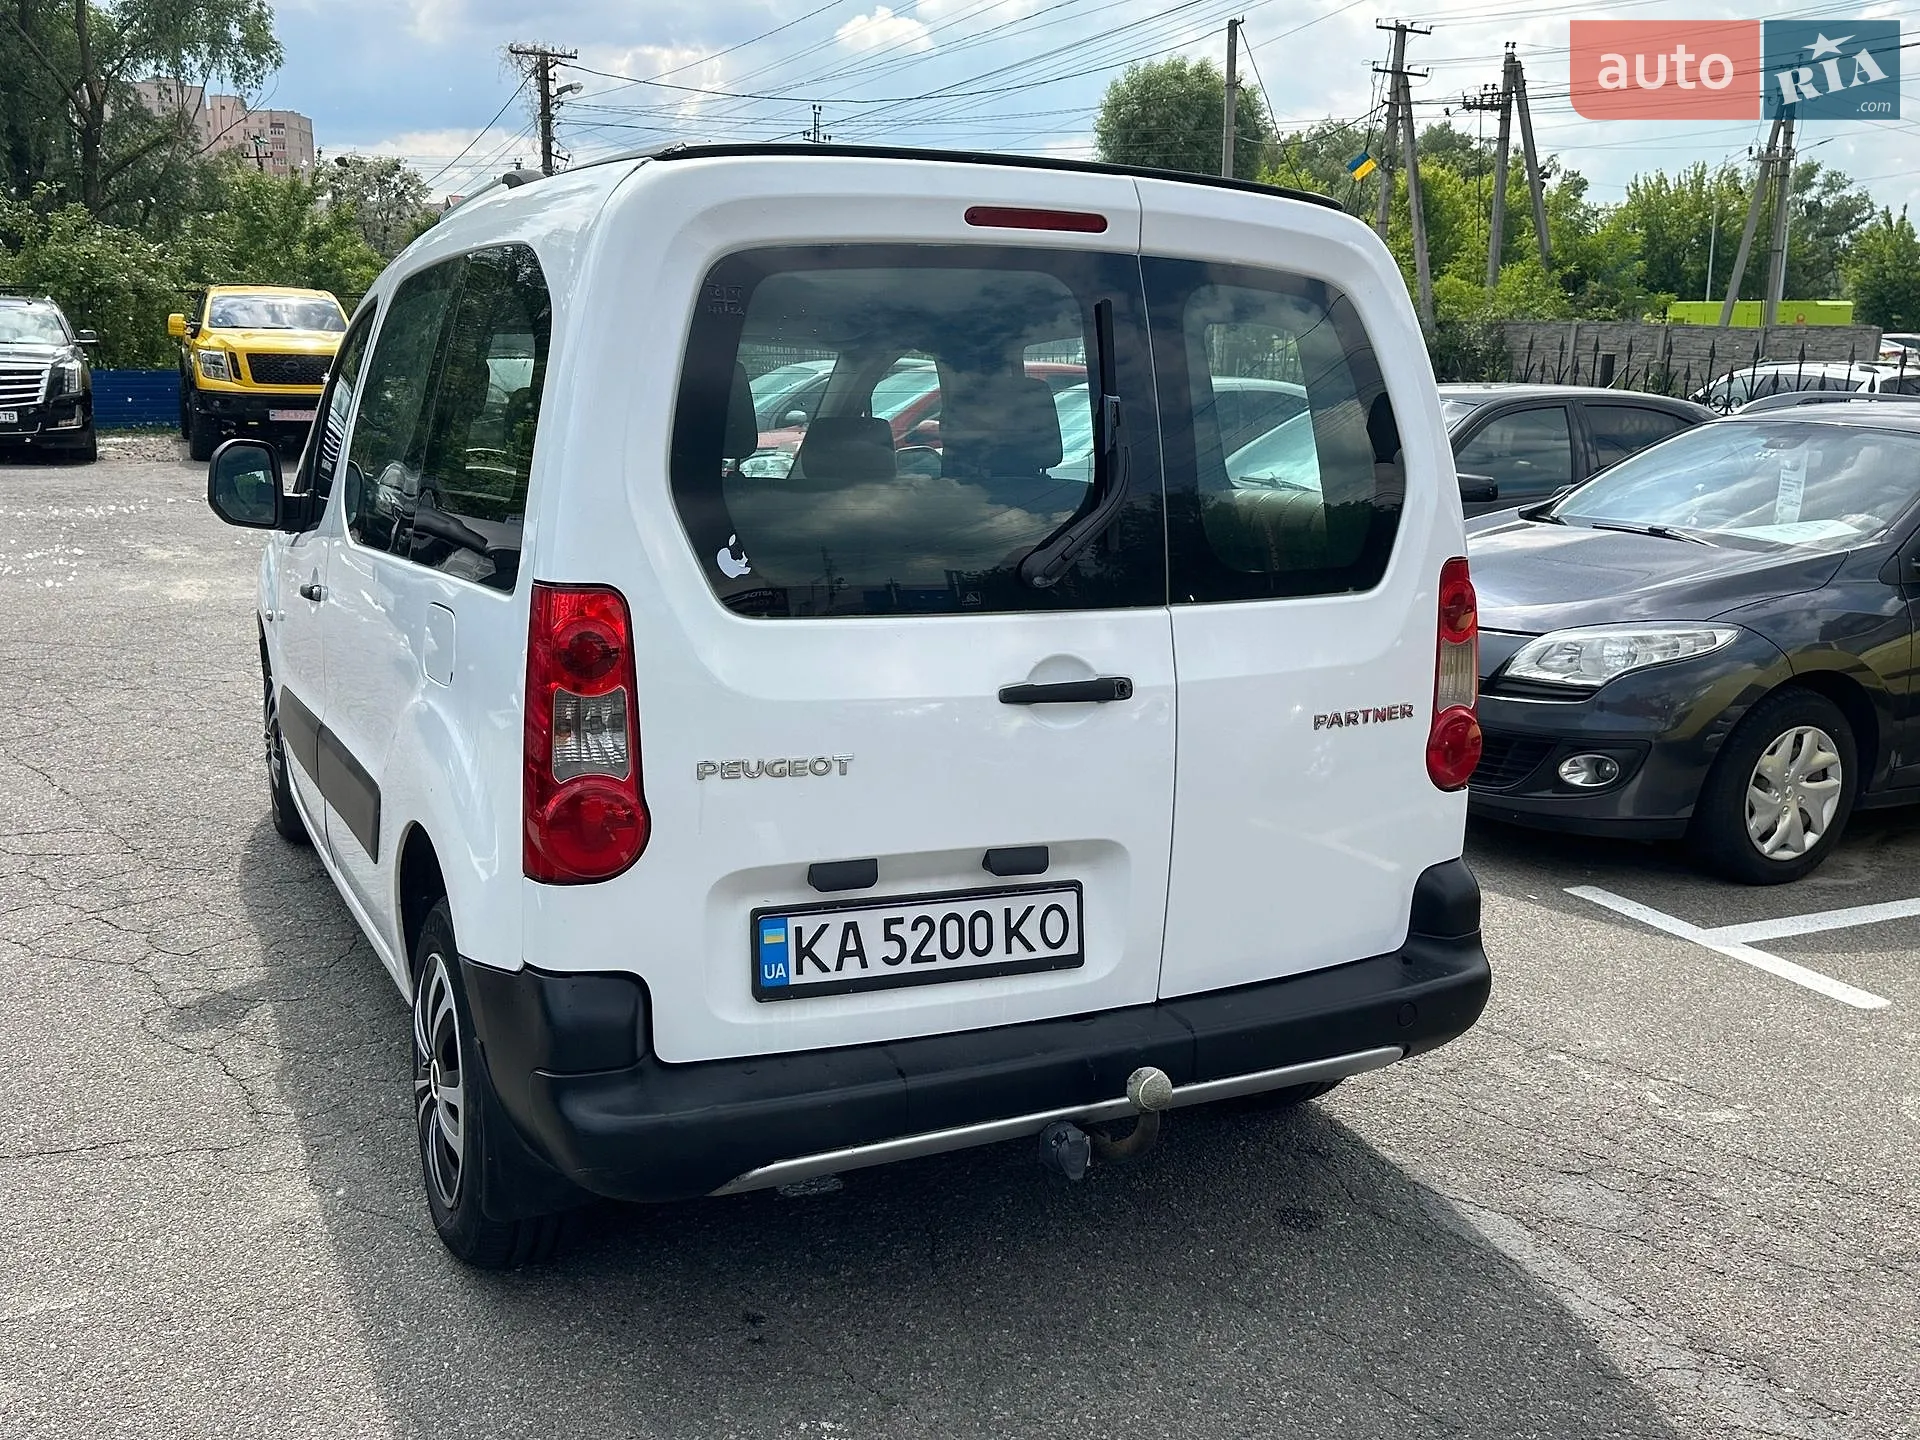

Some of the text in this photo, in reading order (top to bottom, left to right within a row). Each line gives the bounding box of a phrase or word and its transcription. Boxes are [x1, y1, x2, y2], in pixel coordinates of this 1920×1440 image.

[1313, 703, 1414, 731] PARTNER
[696, 752, 855, 780] PEUGEOT
[794, 903, 1070, 976] KA 5200 KO
[763, 962, 787, 980] UA
